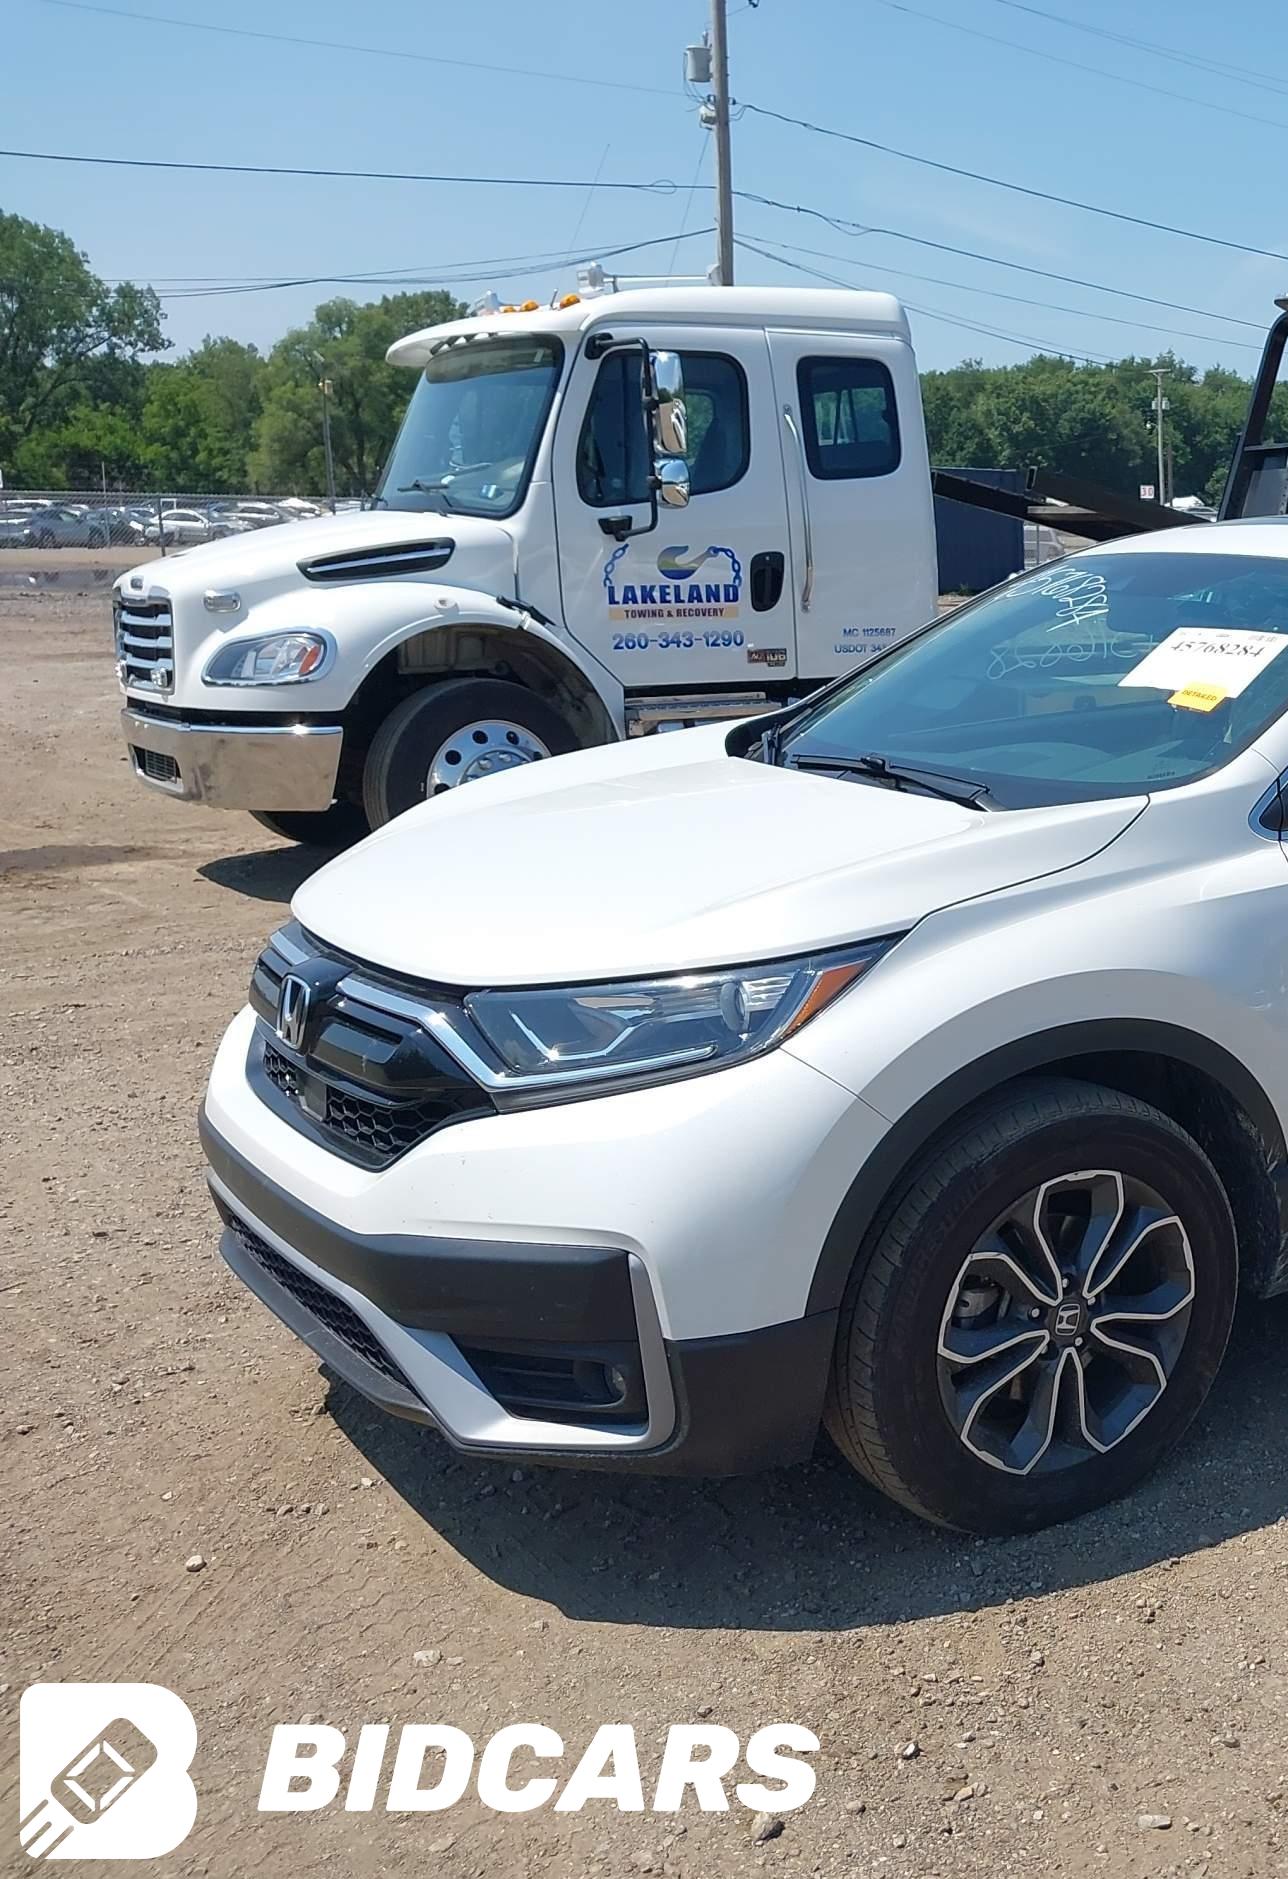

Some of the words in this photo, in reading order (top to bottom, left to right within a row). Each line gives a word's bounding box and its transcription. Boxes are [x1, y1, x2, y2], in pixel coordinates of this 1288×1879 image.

[608, 584, 739, 605] LAKELAND
[624, 609, 664, 619] TOWING
[666, 609, 674, 618] &
[676, 607, 725, 618] RECOVERY
[843, 627, 859, 637] MC
[612, 630, 744, 650] 260-343-1290
[834, 643, 867, 654] USDOT
[1171, 641, 1266, 657] 45768284
